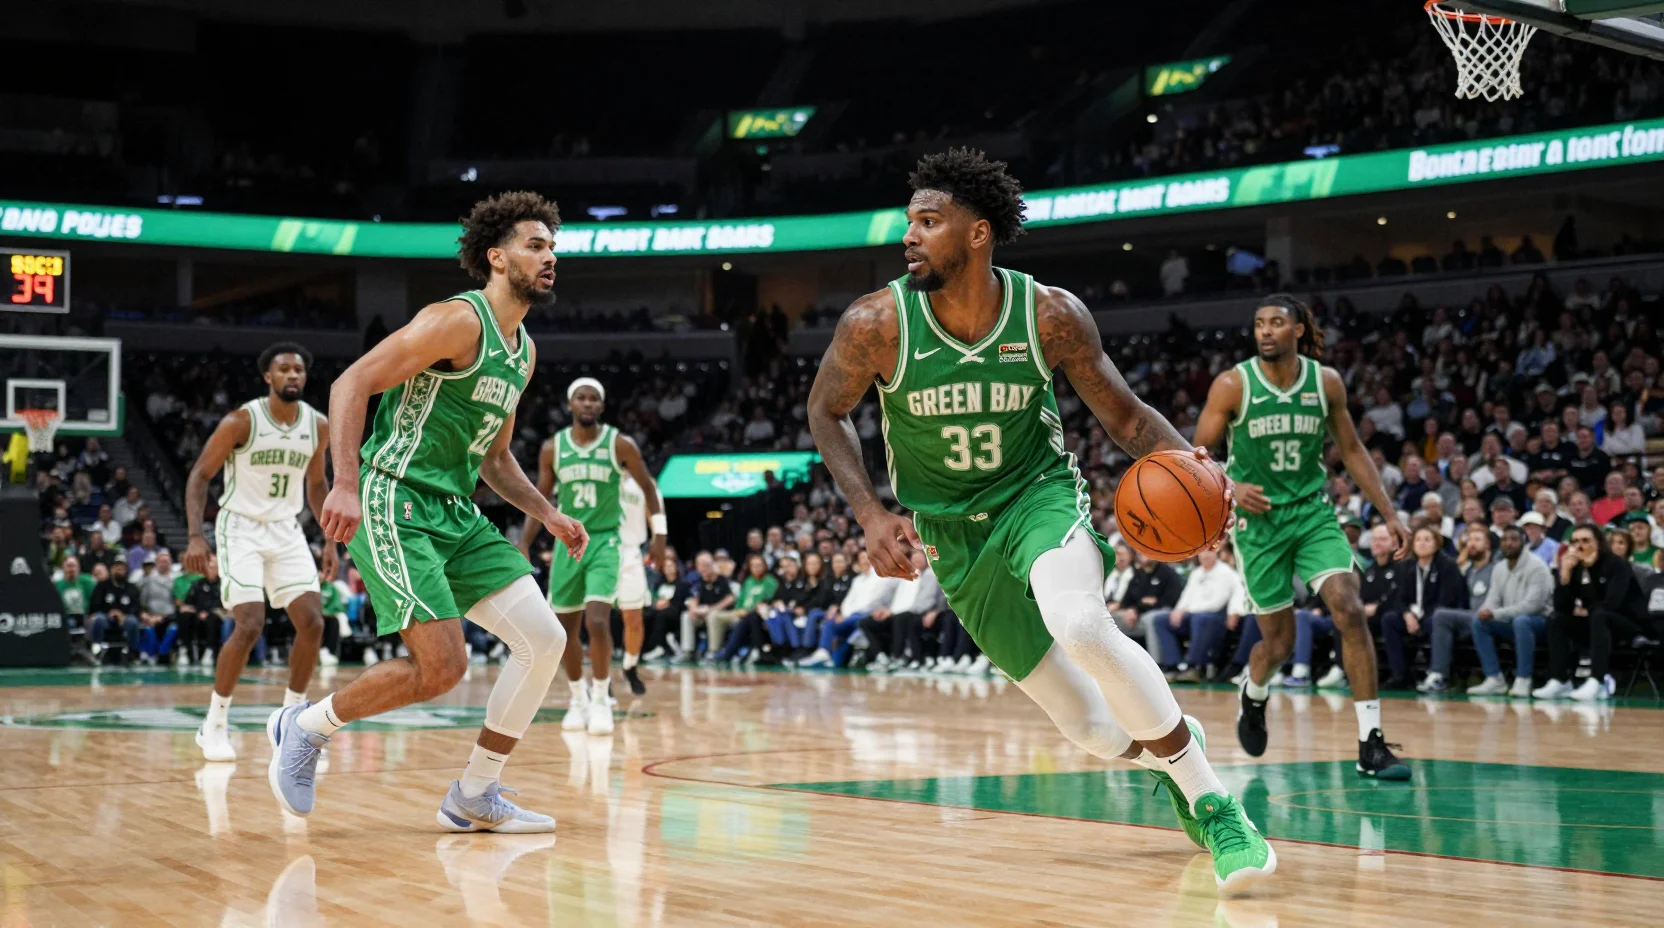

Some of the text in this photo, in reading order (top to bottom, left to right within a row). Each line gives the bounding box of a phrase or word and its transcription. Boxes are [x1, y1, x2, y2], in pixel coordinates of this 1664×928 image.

[906, 381, 1037, 417] GREEN BAY
[1248, 413, 1291, 439] GREEN
[250, 448, 286, 466] GREEN
[940, 422, 1003, 472] 33
[1269, 440, 1302, 472] 35
[268, 472, 291, 499] 31
[571, 481, 598, 510] 24
